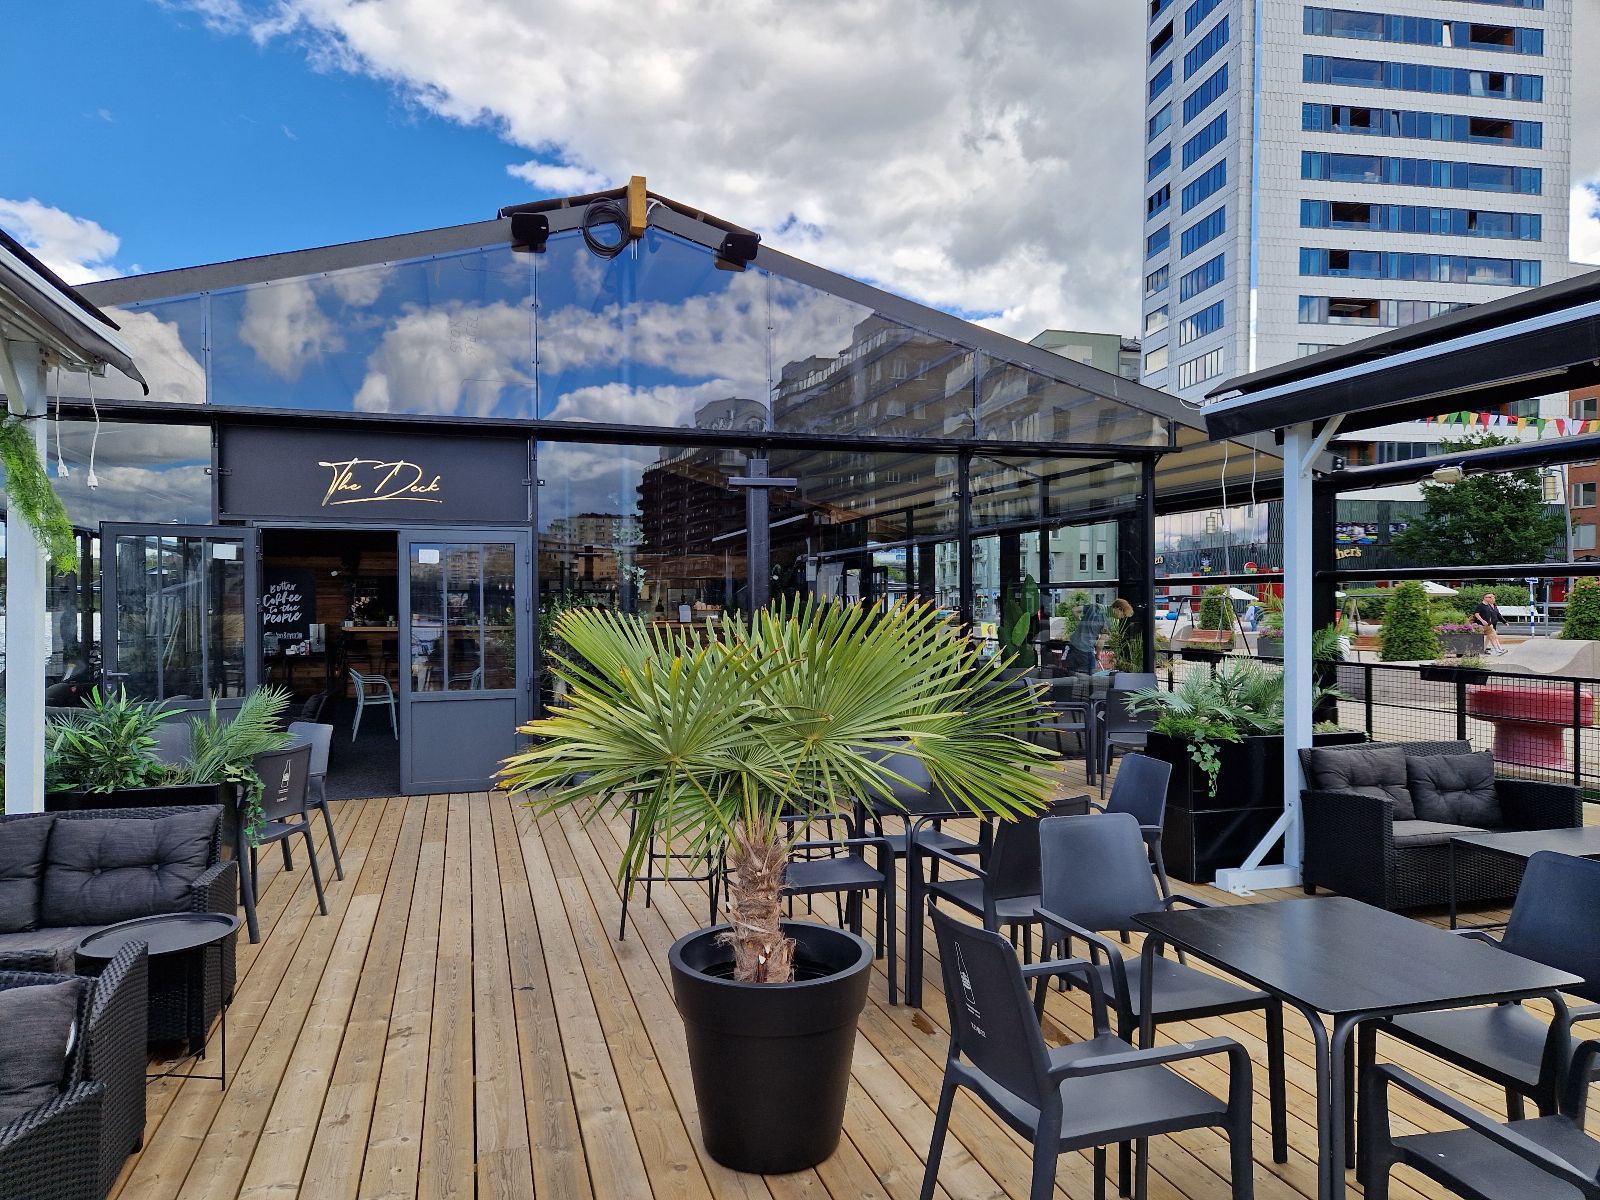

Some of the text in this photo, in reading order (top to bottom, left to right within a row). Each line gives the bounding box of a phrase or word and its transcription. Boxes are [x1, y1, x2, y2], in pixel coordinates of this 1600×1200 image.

[318, 457, 441, 506] The Deck
[270, 581, 297, 594] Better
[263, 591, 302, 607] Coffee
[268, 604, 300, 613] to the
